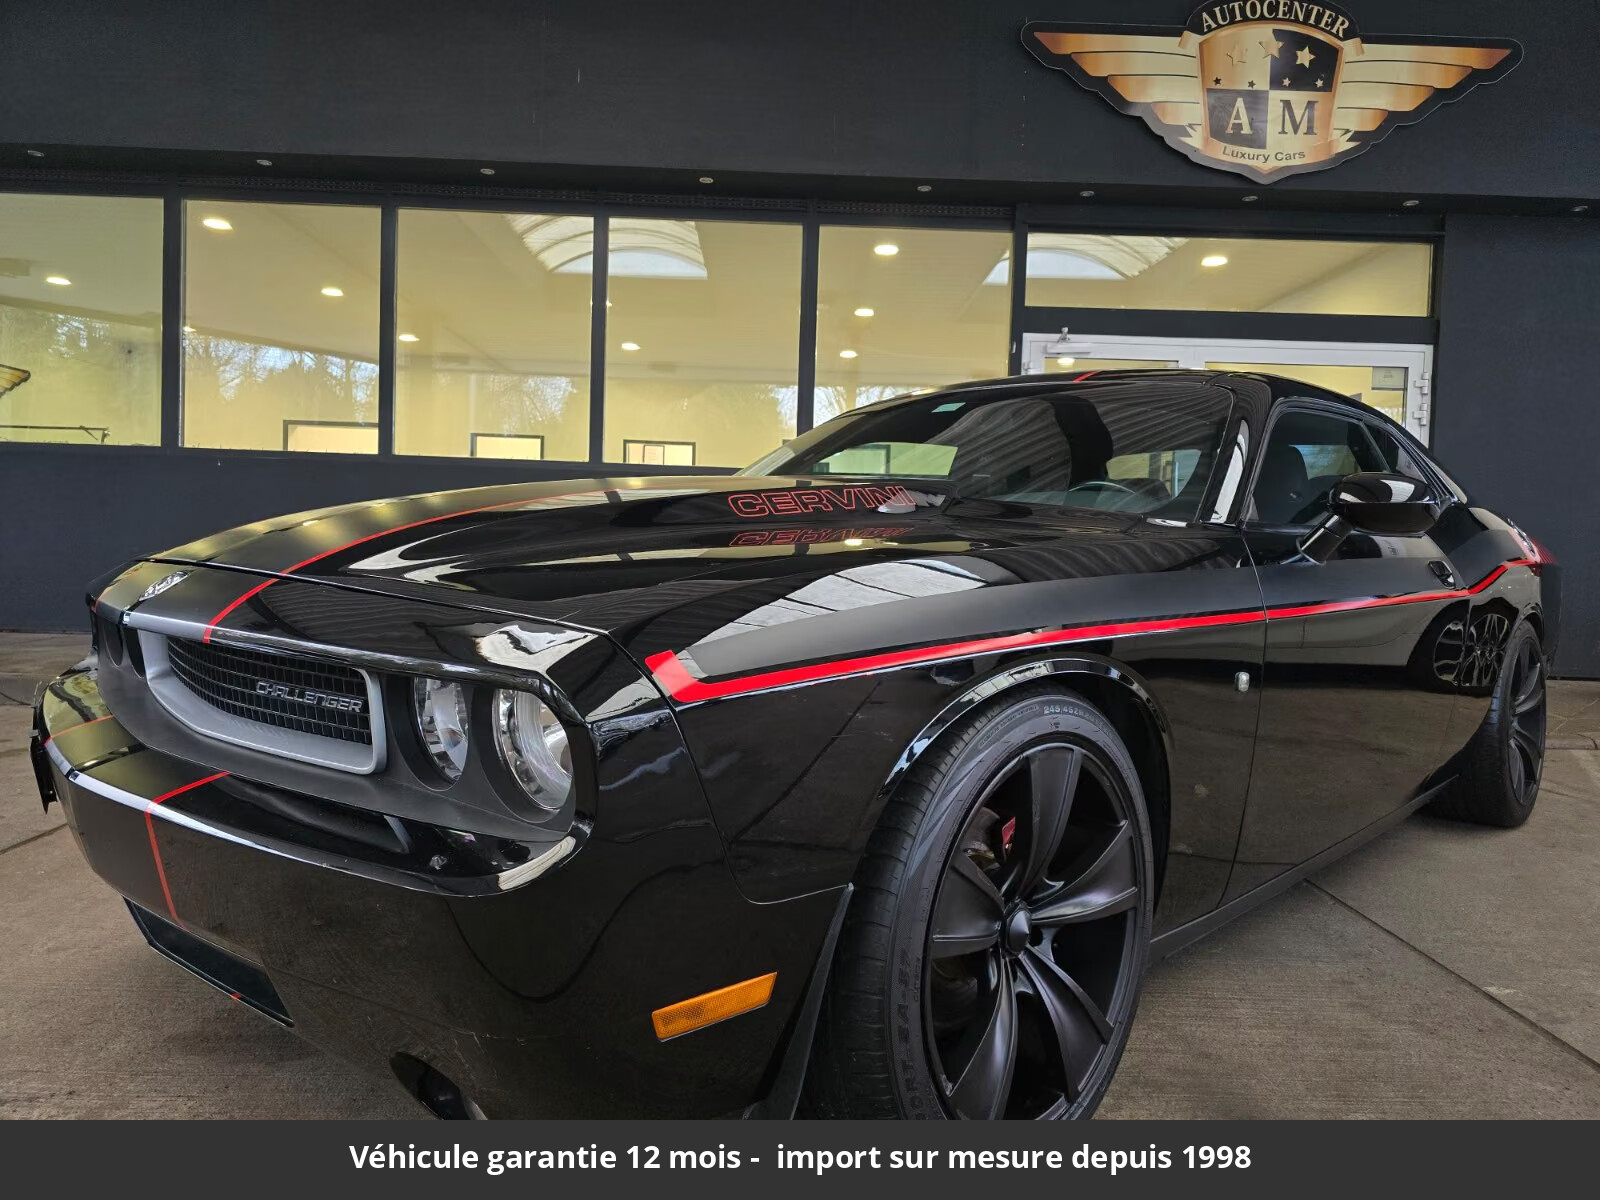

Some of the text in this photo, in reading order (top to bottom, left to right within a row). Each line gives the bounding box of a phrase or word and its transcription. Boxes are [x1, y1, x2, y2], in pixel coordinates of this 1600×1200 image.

[1201, 0, 1350, 38] AUTOCENTER
[1225, 97, 1319, 136] A M
[1222, 145, 1306, 163] Luxury Cars
[728, 486, 916, 518] CERVINI
[257, 681, 362, 713] CHALLENGER
